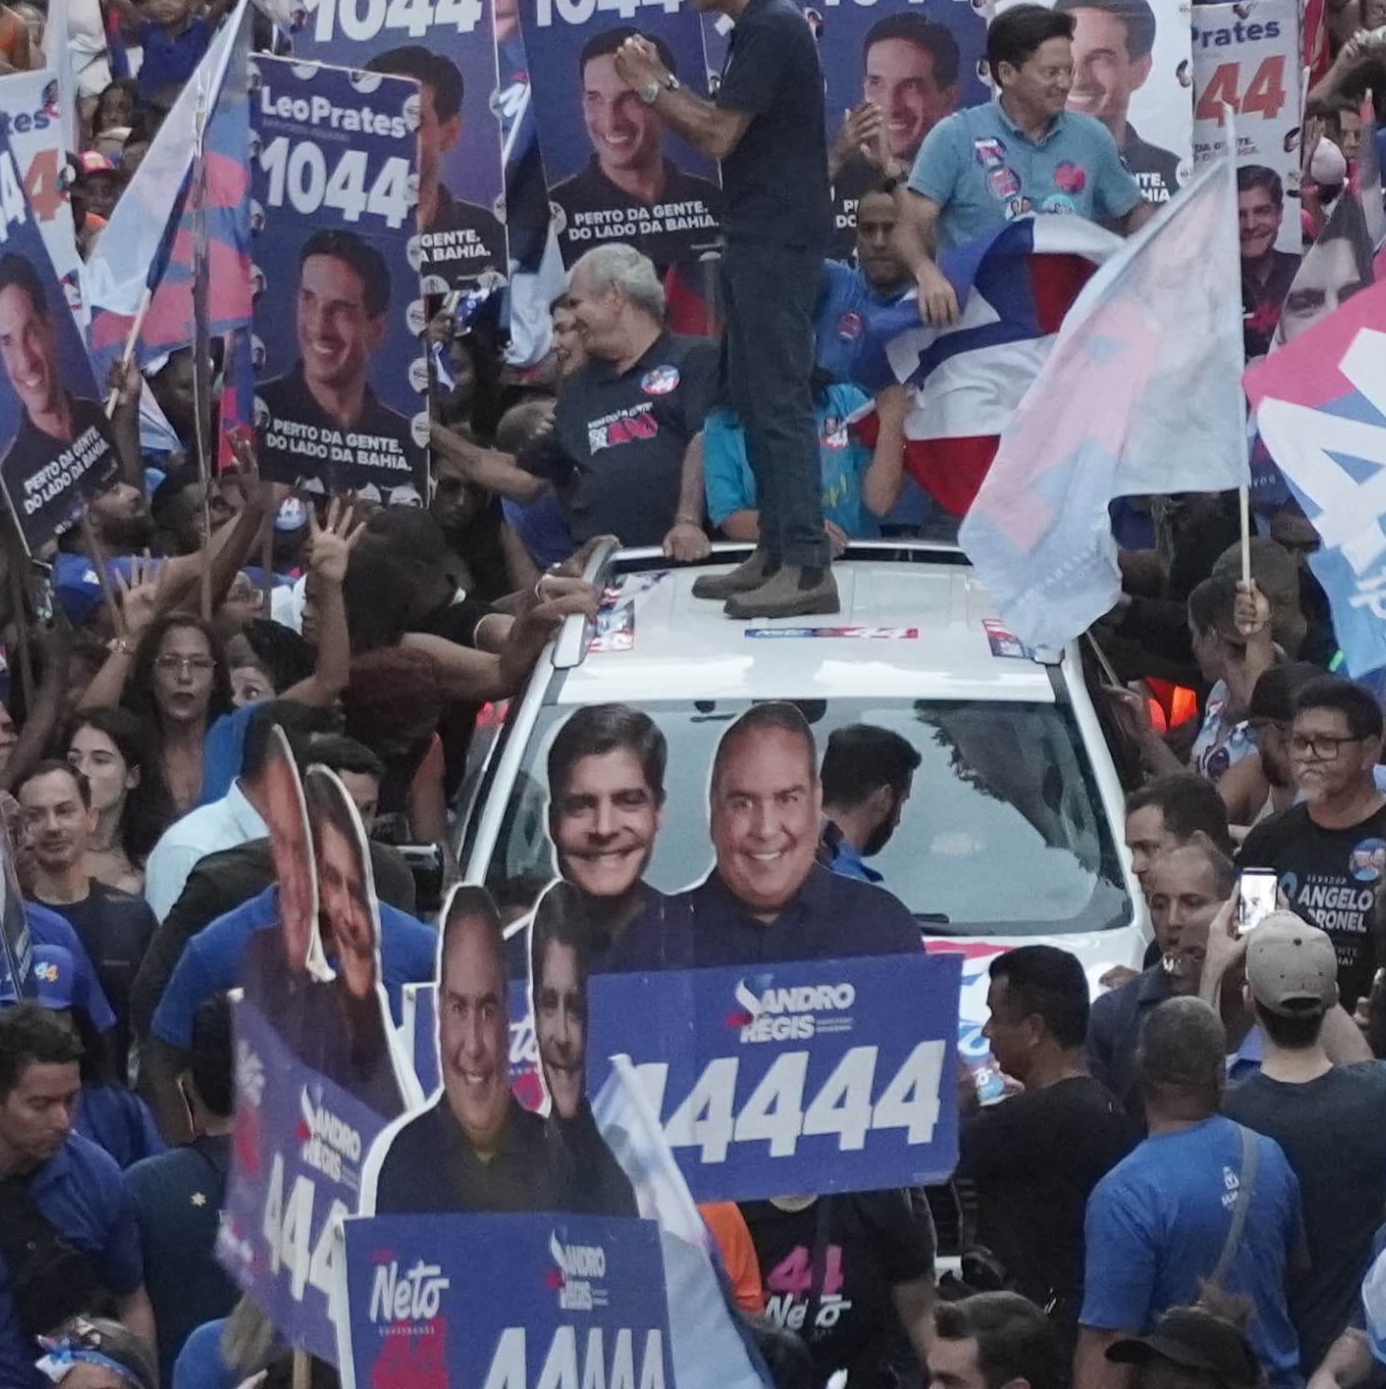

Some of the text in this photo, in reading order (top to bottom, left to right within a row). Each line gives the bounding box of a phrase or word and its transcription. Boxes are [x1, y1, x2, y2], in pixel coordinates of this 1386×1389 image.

[259, 136, 412, 229] 1044
[574, 200, 709, 226] PERTO DA GENTE.
[420, 229, 482, 248] GENTE.
[568, 214, 719, 241] DO LADO DA BAHIA.
[432, 242, 491, 261] BAHIA.
[273, 417, 404, 455] PERTO DA GENTE.
[266, 432, 413, 472] DO LADO DA BAHIA.
[1297, 884, 1374, 911] ANGELO
[740, 1014, 815, 1044] RÉGIS
[369, 1259, 450, 1324] Neto
